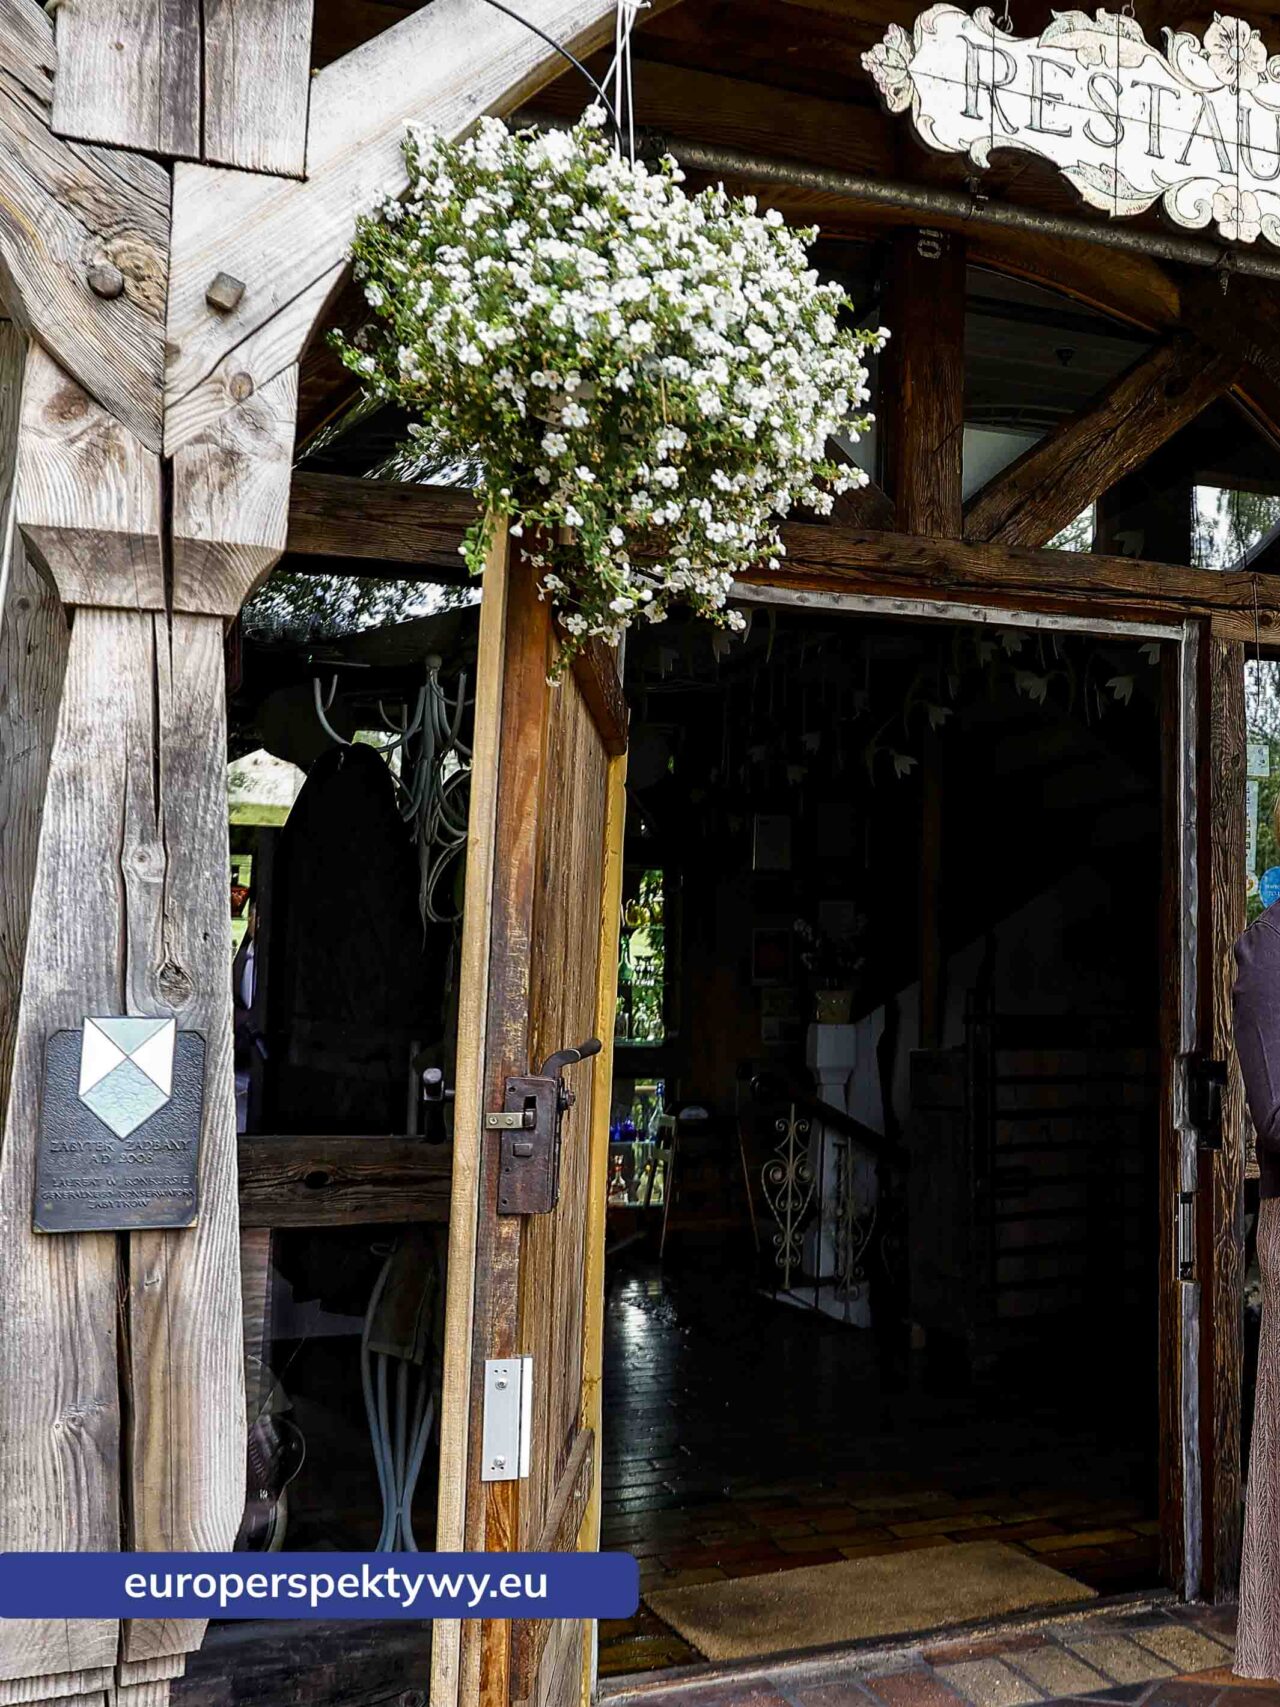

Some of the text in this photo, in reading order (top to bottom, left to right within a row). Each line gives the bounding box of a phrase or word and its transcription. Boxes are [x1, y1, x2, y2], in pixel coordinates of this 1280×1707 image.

[51, 1139, 193, 1152] ZABYTEK ZADBANY
[52, 1177, 105, 1188] LAUREAT
